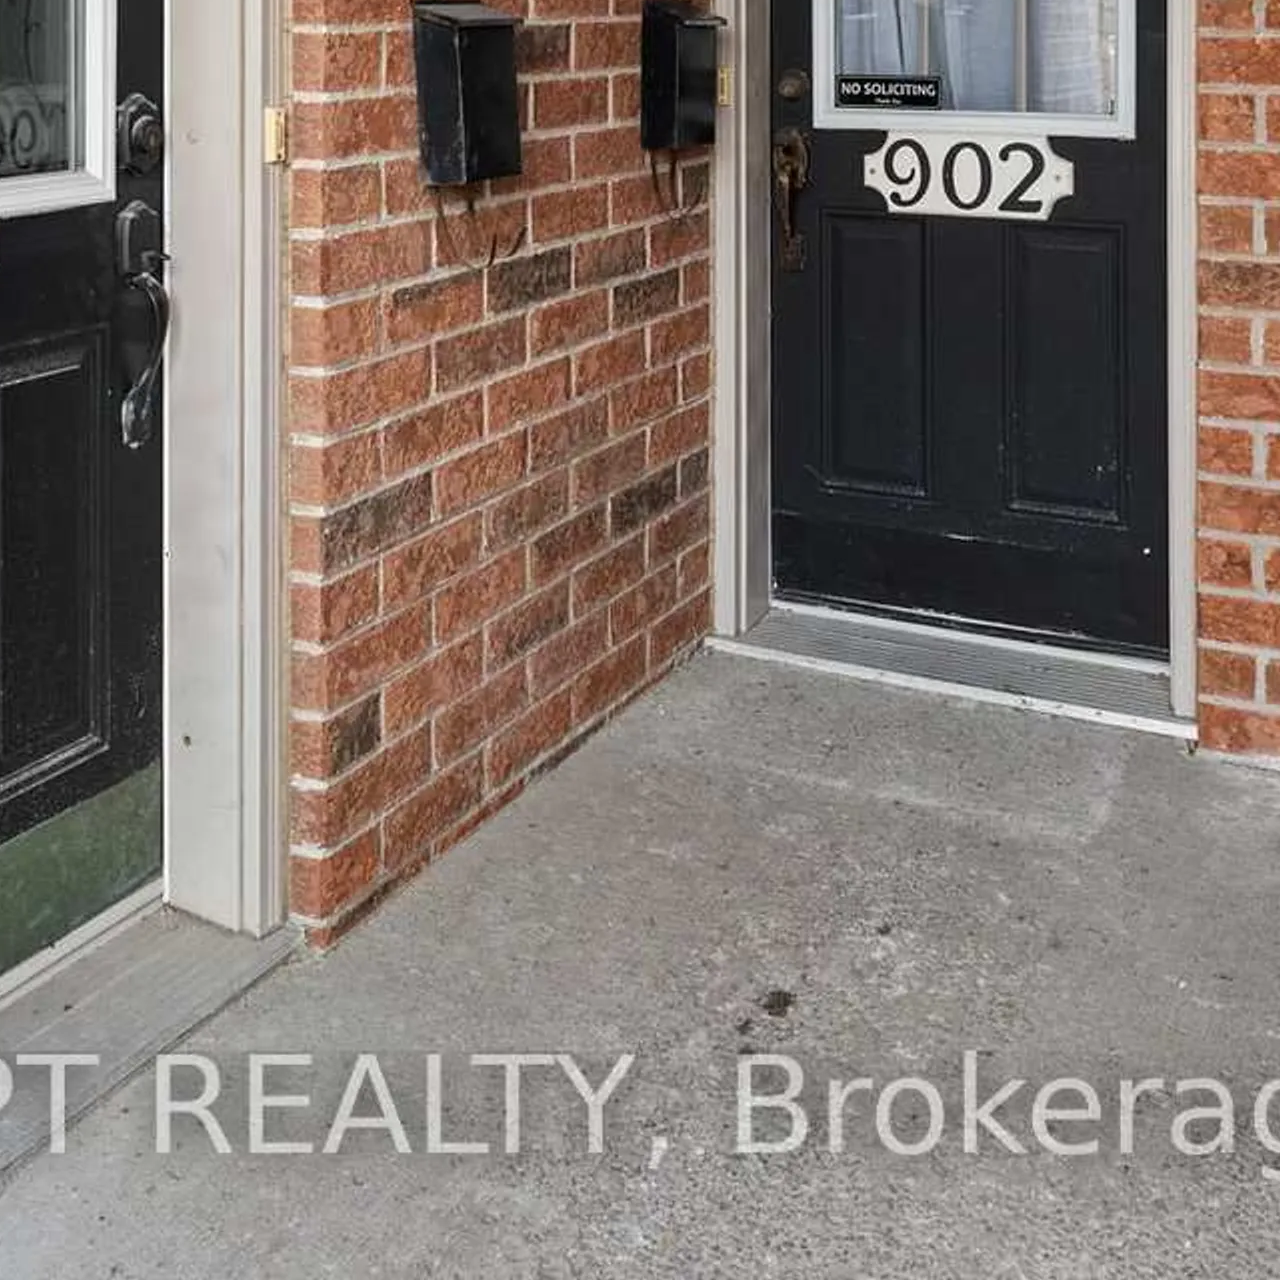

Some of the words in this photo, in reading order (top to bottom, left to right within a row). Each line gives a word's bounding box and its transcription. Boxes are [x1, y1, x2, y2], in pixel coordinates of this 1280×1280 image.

[841, 82, 862, 95] NO
[864, 82, 936, 97] SOLICITING
[883, 138, 1046, 213] 902
